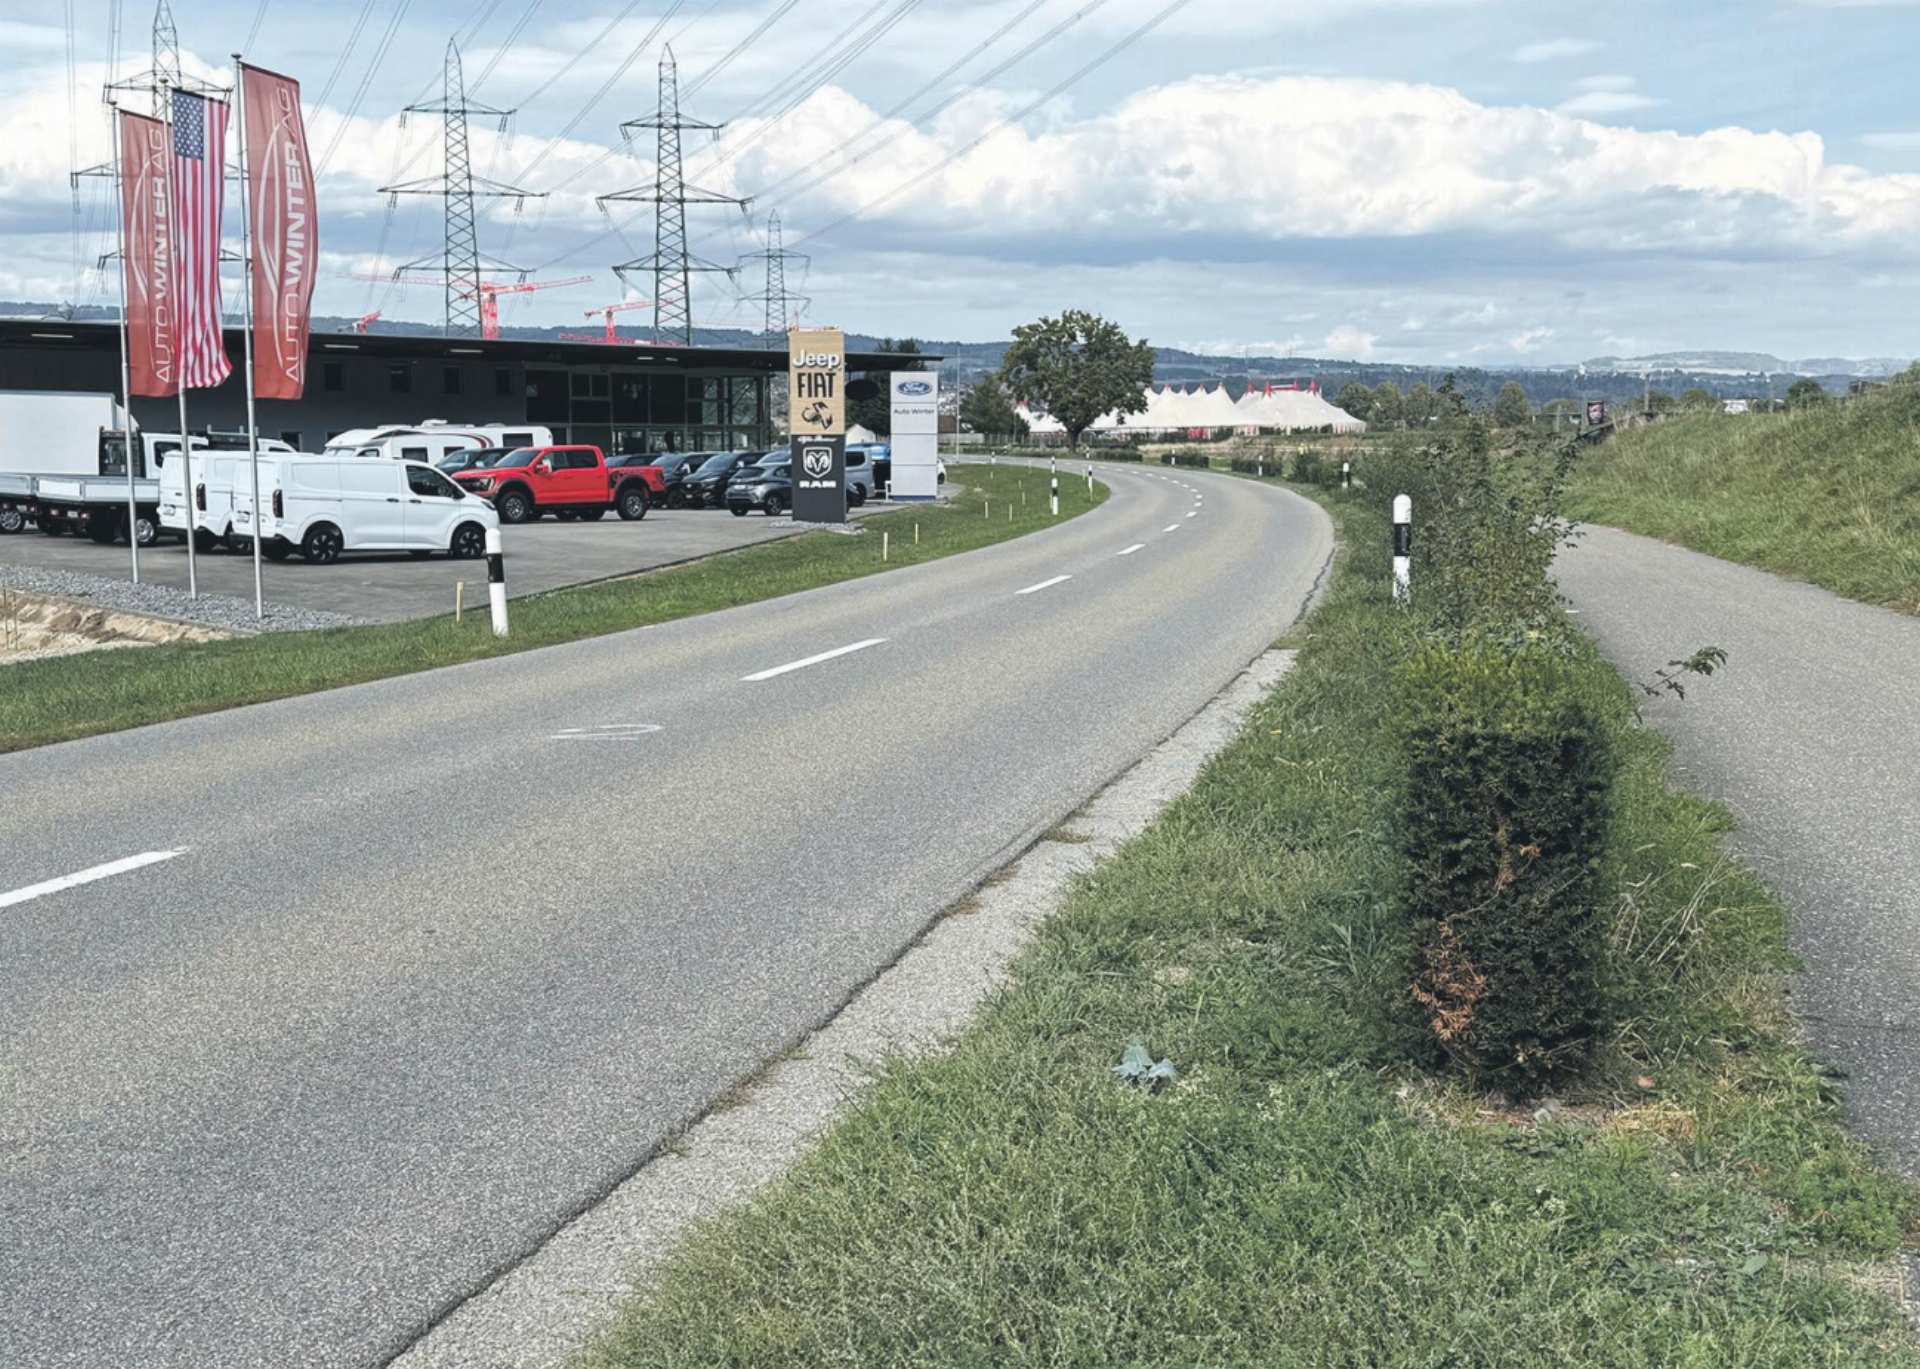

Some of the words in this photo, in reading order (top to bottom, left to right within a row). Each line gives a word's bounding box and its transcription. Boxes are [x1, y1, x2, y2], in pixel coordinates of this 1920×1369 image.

[276, 86, 297, 140] AG
[149, 128, 165, 172] AG
[152, 176, 168, 300] WINTER
[284, 141, 304, 286] WINTER
[155, 305, 171, 384] AUTO
[285, 292, 300, 384] AUTO
[792, 349, 841, 370] Jeep
[797, 372, 837, 398] FIAT
[799, 480, 837, 488] RAM
